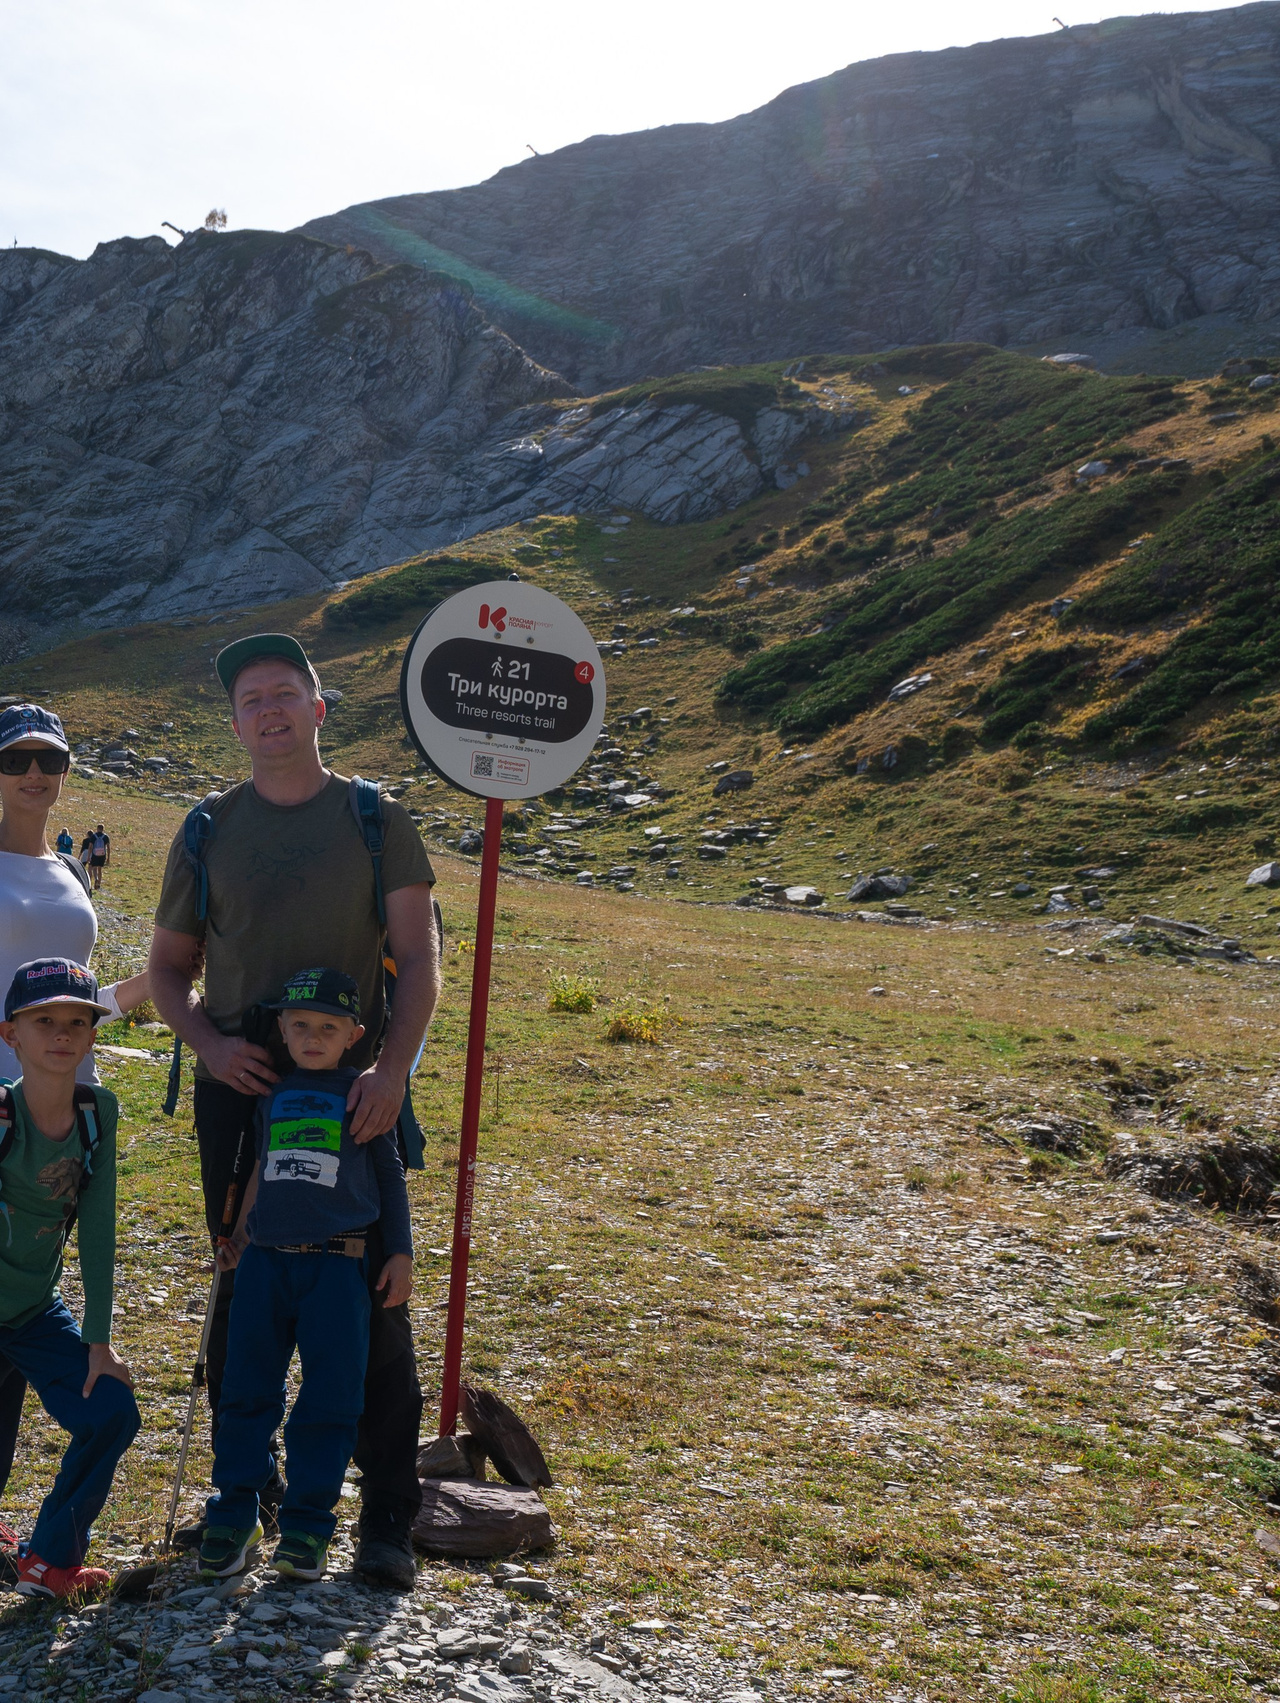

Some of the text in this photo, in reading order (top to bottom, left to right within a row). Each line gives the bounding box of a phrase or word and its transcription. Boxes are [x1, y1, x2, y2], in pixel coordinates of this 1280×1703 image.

[508, 622, 532, 630] ПОЛЯНА
[509, 616, 534, 625] КРАСНАЯ
[507, 660, 531, 681] 21
[579, 666, 589, 679] 4
[447, 672, 568, 710] Три курорта
[455, 702, 556, 729] Three resorts trail
[1, 727, 15, 738] BMW
[458, 736, 491, 746] Спасательная
[27, 964, 66, 979] Red Bull
